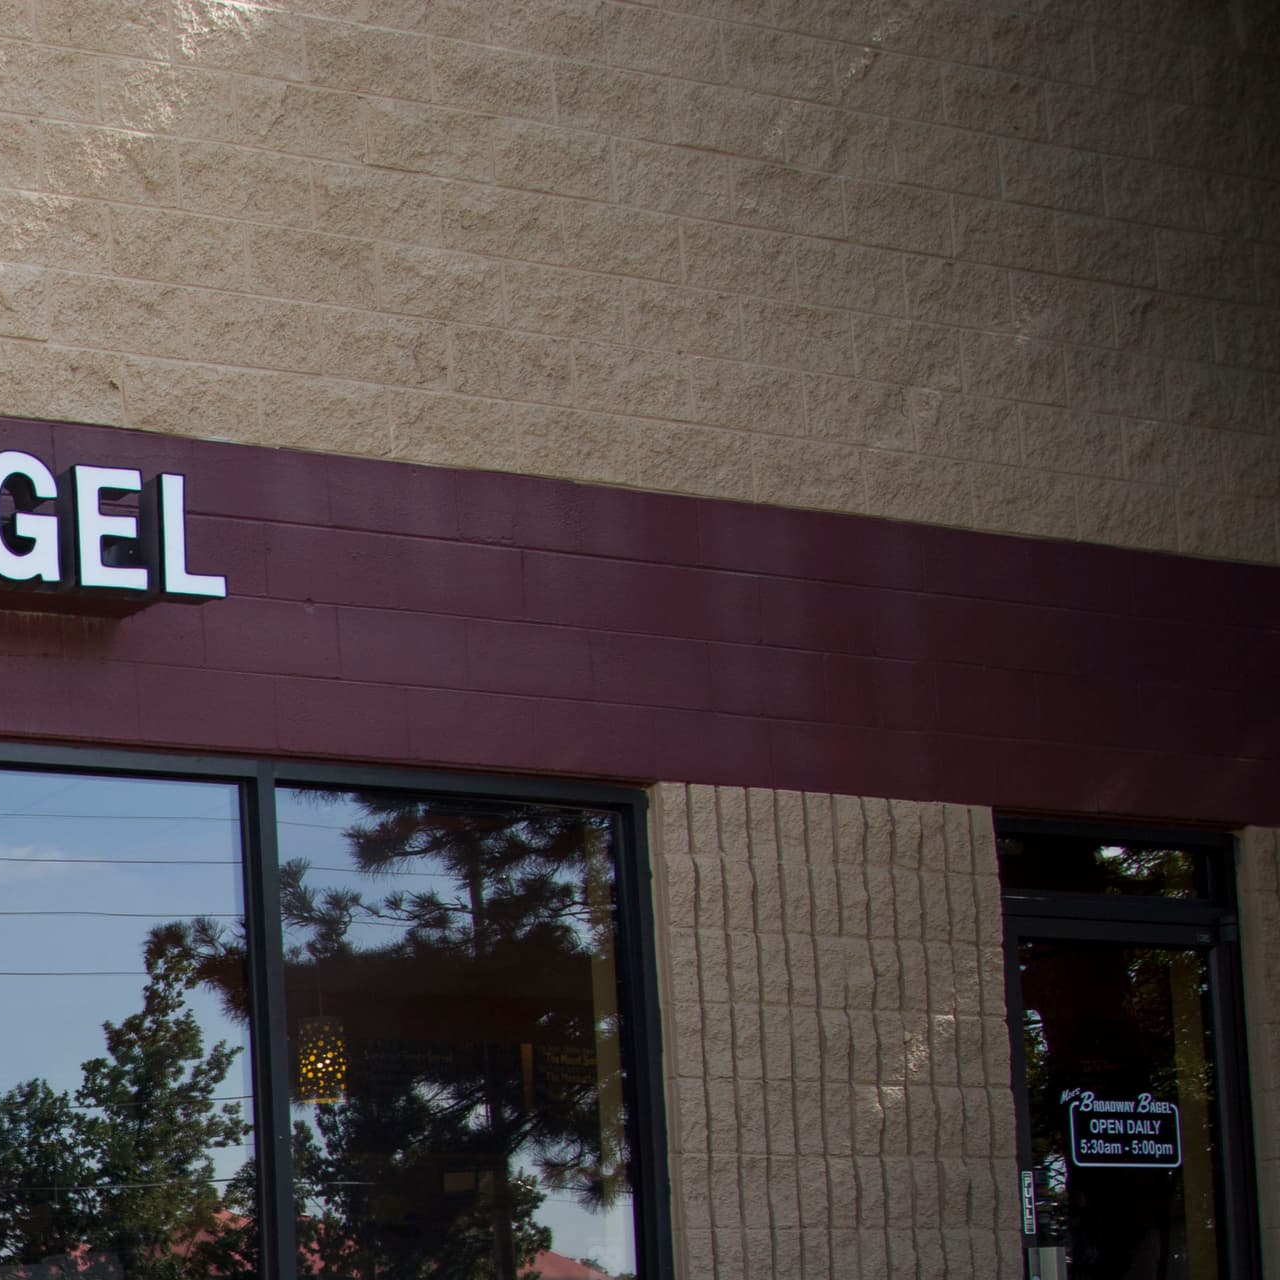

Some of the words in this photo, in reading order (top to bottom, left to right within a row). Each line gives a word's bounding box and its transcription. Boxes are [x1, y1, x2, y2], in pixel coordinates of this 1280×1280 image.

[1089, 1119, 1124, 1134] OPEN
[1126, 1119, 1161, 1135] DAILY
[1080, 1139, 1122, 1155] 5:30am
[1131, 1140, 1174, 1158] 5:00pm
